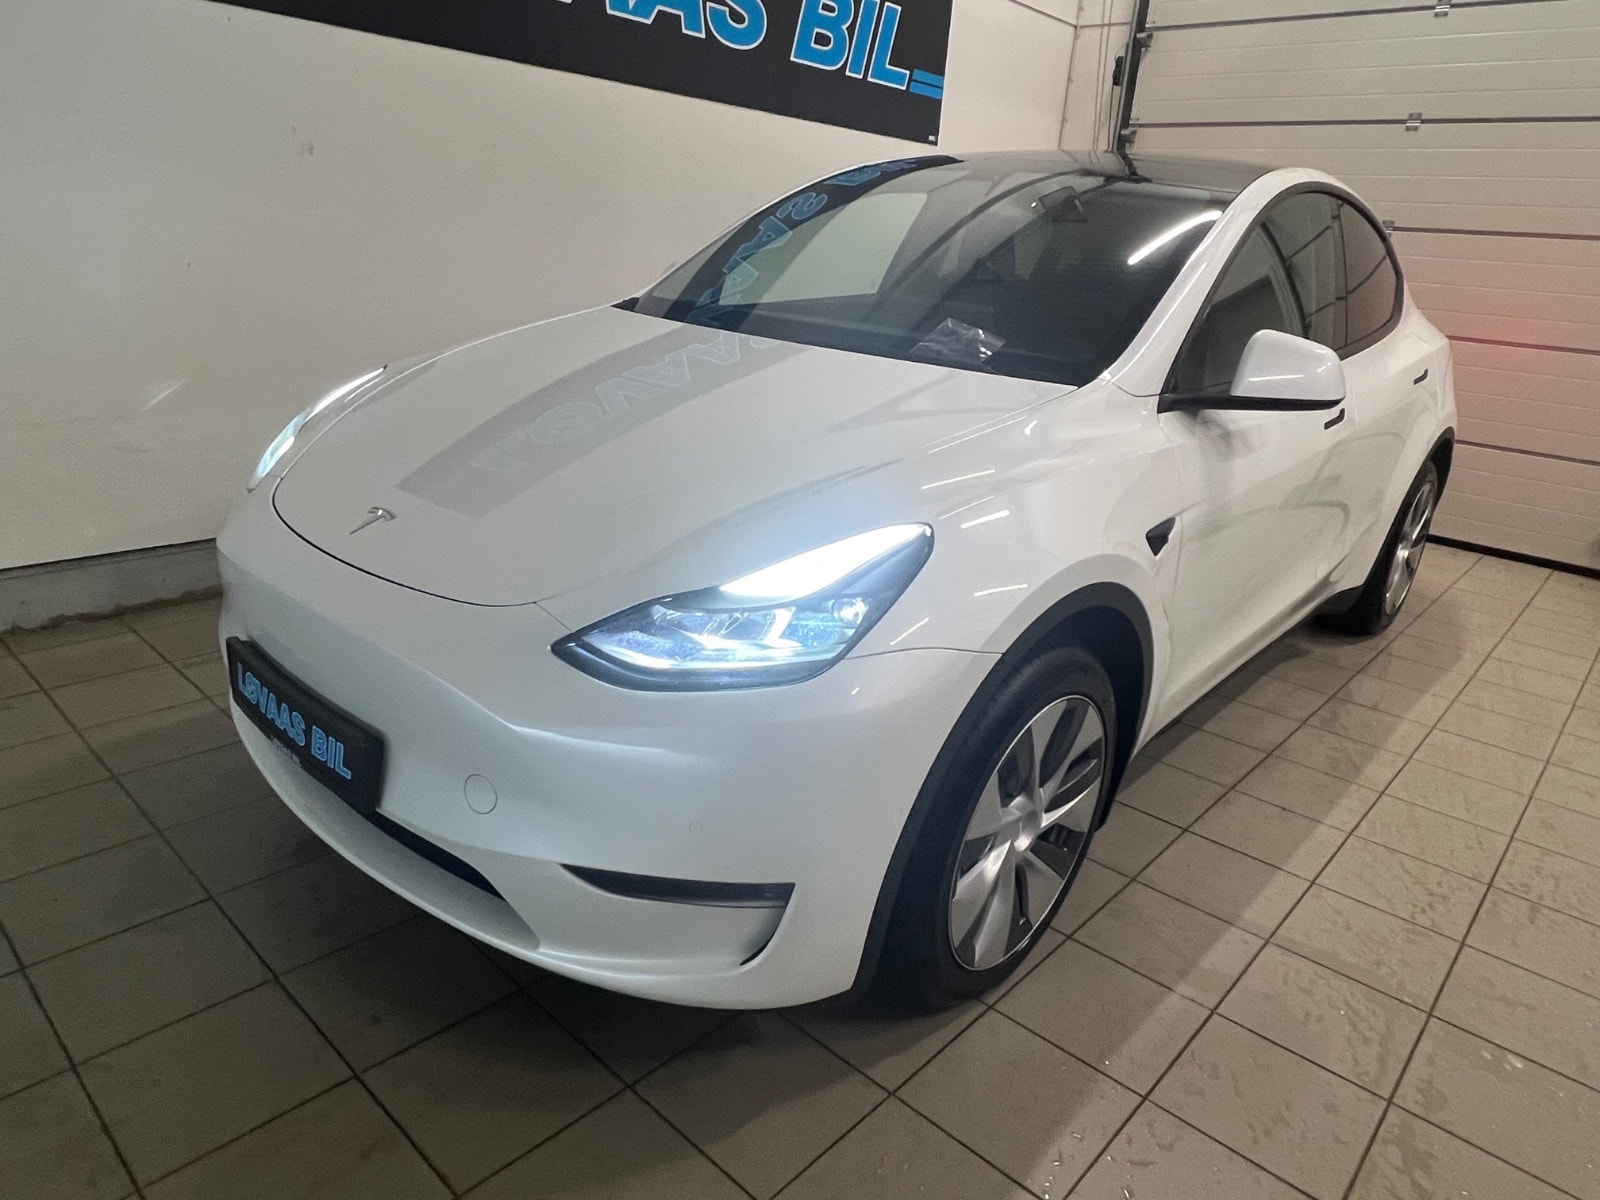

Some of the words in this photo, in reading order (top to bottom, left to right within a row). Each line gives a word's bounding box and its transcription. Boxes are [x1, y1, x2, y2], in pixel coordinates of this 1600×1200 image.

[789, 0, 911, 90] BIL
[236, 661, 306, 747] LØVAAS
[311, 724, 352, 780] BIL
